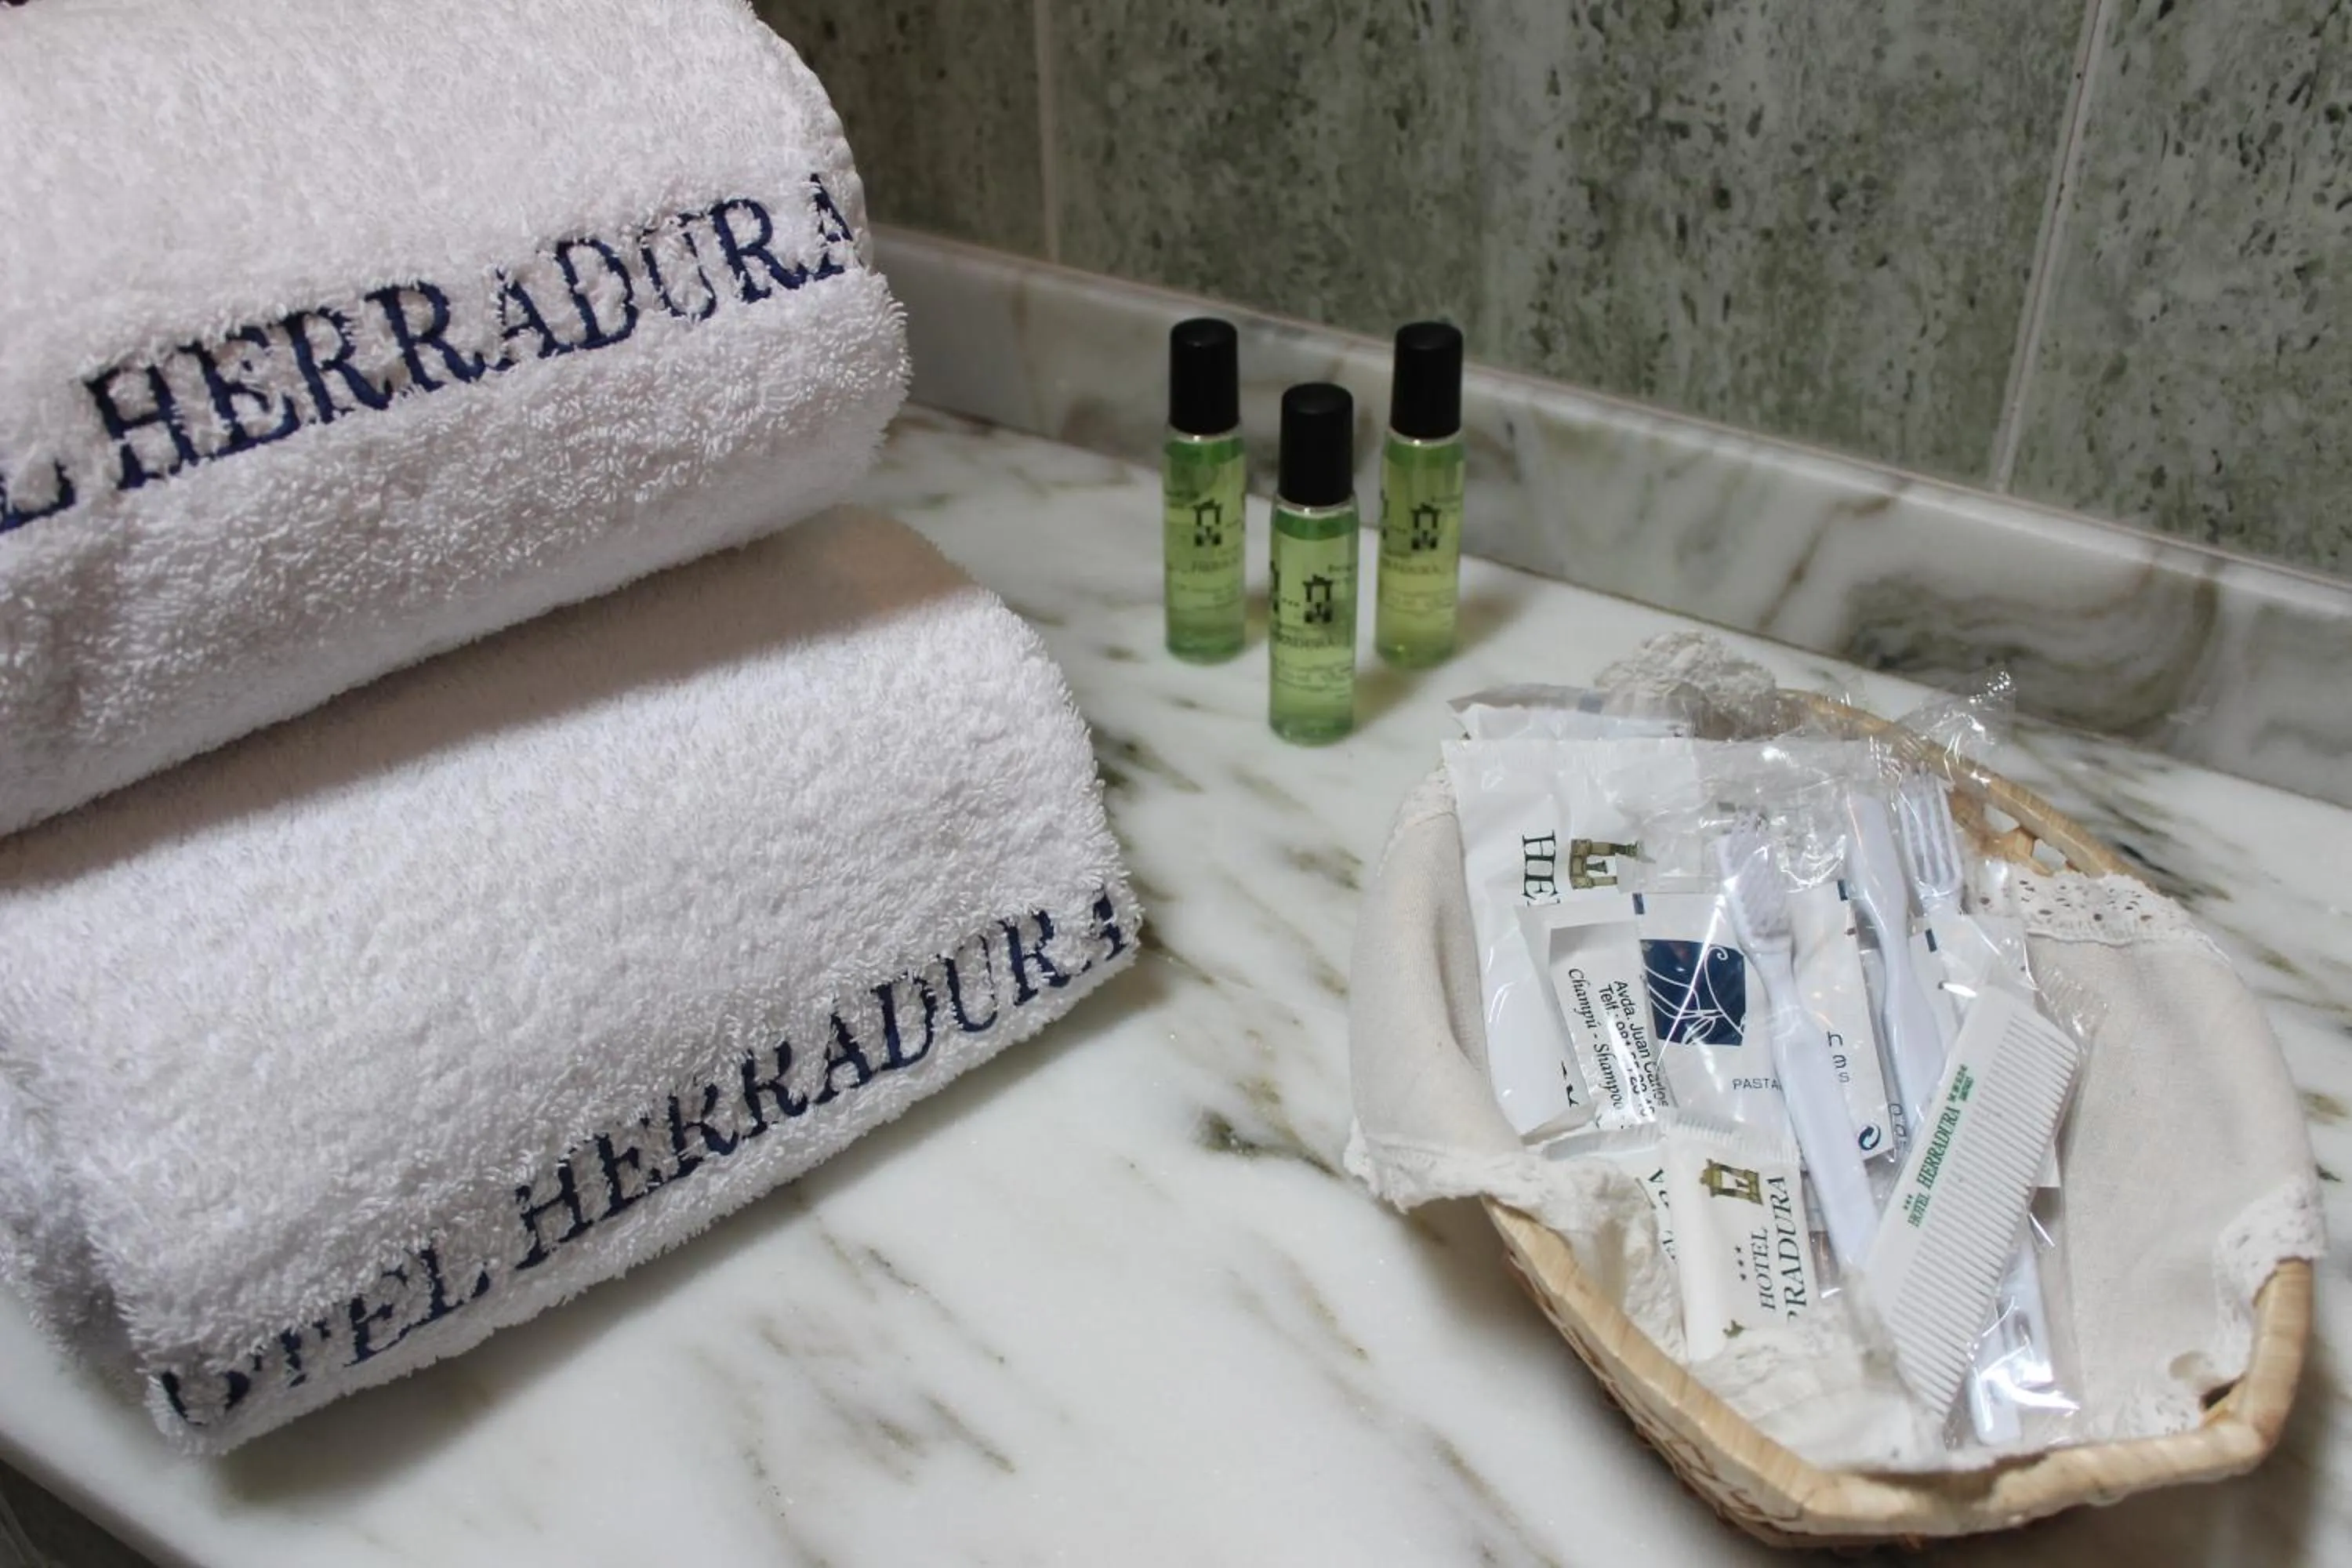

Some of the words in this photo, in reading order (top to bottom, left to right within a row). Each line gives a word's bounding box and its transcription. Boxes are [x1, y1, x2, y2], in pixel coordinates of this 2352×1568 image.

[83, 172, 856, 491] HERRADURA
[1522, 829, 1560, 906] HE
[515, 887, 1127, 1270] HERRADURA
[1630, 1022, 1650, 1058] Juan
[1915, 1105, 1961, 1190] HERRADURA
[1751, 1227, 1776, 1311] HOTEL
